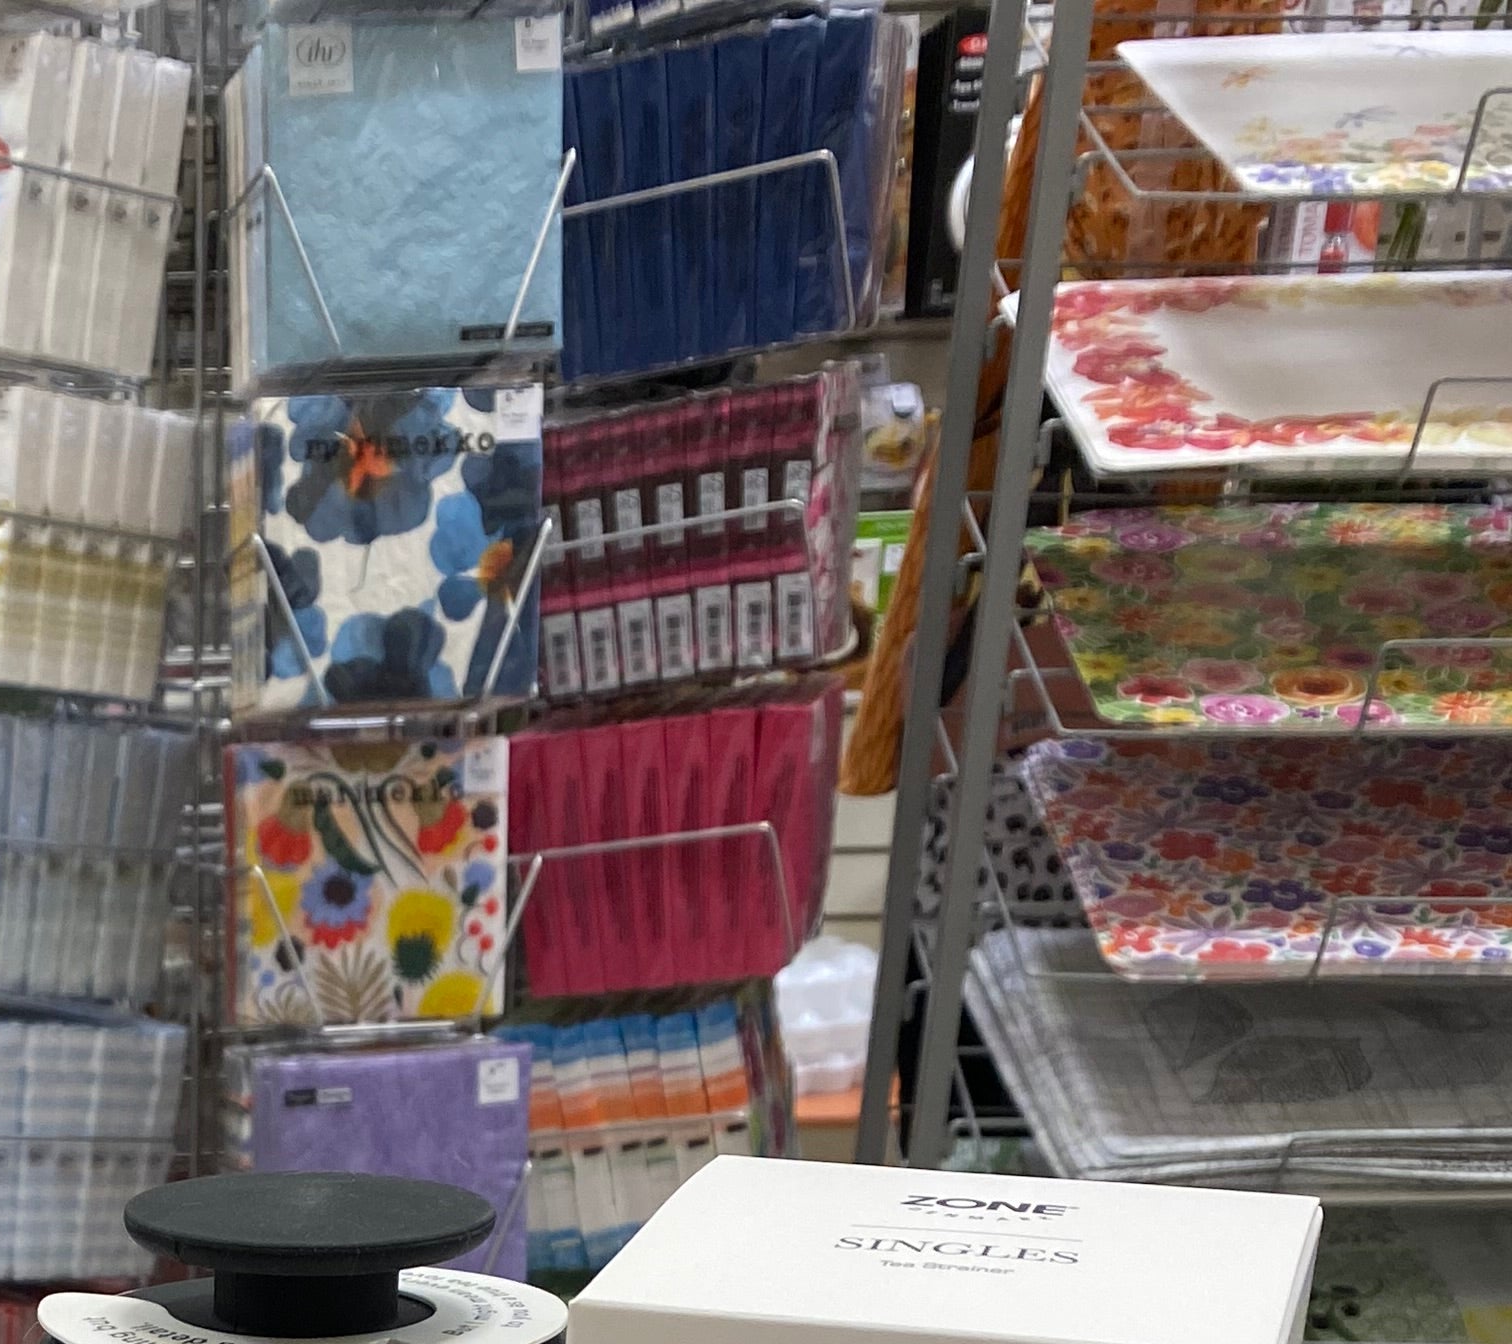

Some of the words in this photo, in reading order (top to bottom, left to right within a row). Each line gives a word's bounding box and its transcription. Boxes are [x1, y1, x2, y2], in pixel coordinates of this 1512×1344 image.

[900, 1195, 1067, 1216] ZONE
[835, 1236, 1080, 1265] SINGLES
[880, 1259, 916, 1269] Tea
[922, 1261, 1016, 1275] Strainer
